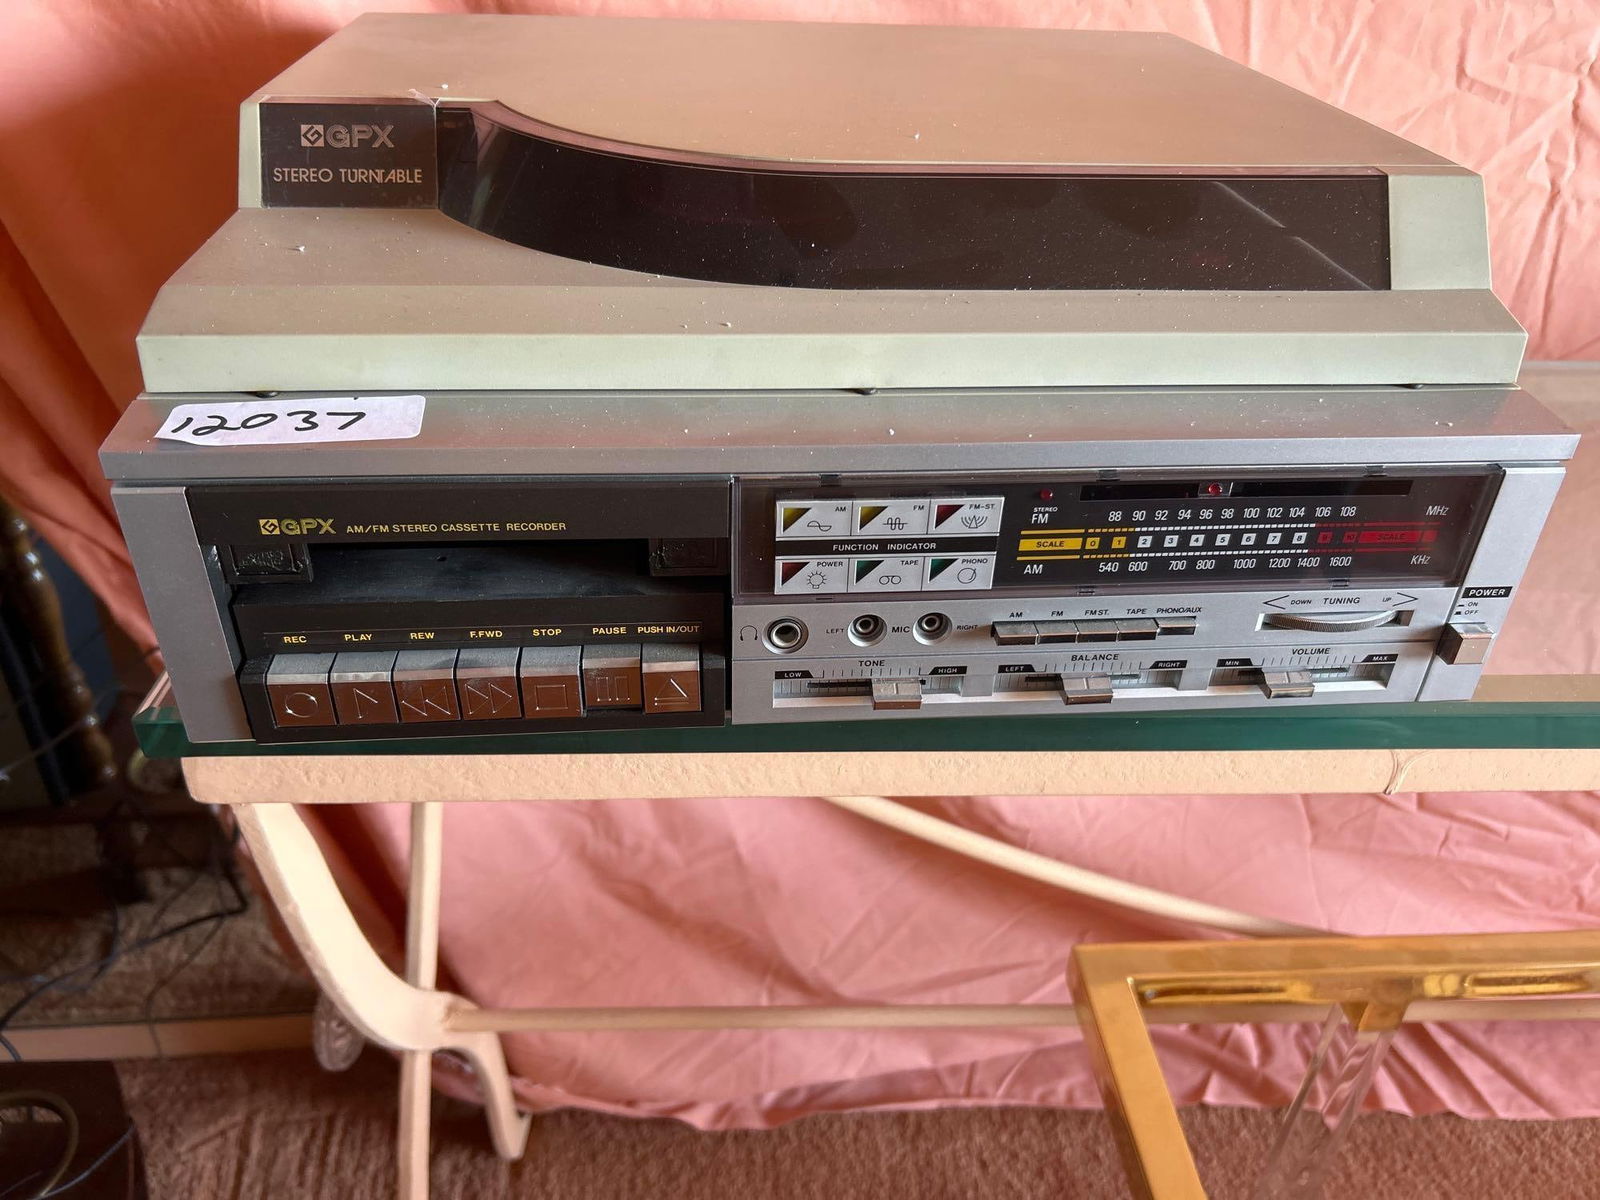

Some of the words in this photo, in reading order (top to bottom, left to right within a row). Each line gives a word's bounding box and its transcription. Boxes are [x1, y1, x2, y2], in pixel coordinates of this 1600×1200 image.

[326, 124, 394, 148] GPX
[273, 167, 333, 183] STEREO
[339, 168, 422, 183] TURNTABLE
[171, 410, 366, 436] 12037
[1031, 513, 1049, 524] FM
[1108, 511, 1122, 522] 88
[1132, 510, 1146, 521] 90
[1154, 510, 1169, 521] 92
[1177, 509, 1191, 520] 94
[1199, 509, 1213, 519] 96
[1220, 508, 1234, 519] 98
[1243, 508, 1260, 518] 100
[1266, 507, 1283, 518] 102
[1289, 507, 1305, 517] 104
[1315, 506, 1332, 517] 106
[1340, 506, 1357, 517] 108
[1426, 506, 1449, 516] MHz
[280, 518, 337, 535] GPX
[346, 524, 389, 534] AM/FM
[392, 523, 437, 533] STEREO
[441, 523, 500, 532] CASSETTE
[506, 522, 567, 531] RECORDER
[832, 543, 879, 551] FUNCTION
[887, 542, 937, 550] INDICATOR
[1036, 540, 1065, 548] SCALE
[1024, 564, 1043, 575] AM
[1099, 562, 1119, 573] 540
[1128, 561, 1148, 572] 600
[1168, 560, 1187, 571] 700
[1196, 559, 1215, 570] 800
[1233, 558, 1256, 569] 1000
[1268, 557, 1291, 568] 1200
[1297, 557, 1320, 567] 1400
[1329, 556, 1352, 567] 1600
[1410, 555, 1431, 565] KHz
[1469, 588, 1506, 597] POWER
[1323, 597, 1360, 605] TUNING
[1157, 606, 1202, 614] PHONO/AUX
[533, 628, 562, 636] STOP
[592, 626, 627, 635] PAUSE
[637, 625, 664, 633] PUSH
[666, 625, 700, 633] IN/OUT
[344, 633, 373, 642] PLAY
[410, 631, 435, 640] REW
[470, 630, 503, 639] F.FWD
[284, 635, 307, 644] REC
[1292, 647, 1331, 655] VOLUME
[1071, 653, 1120, 662] BALANCE
